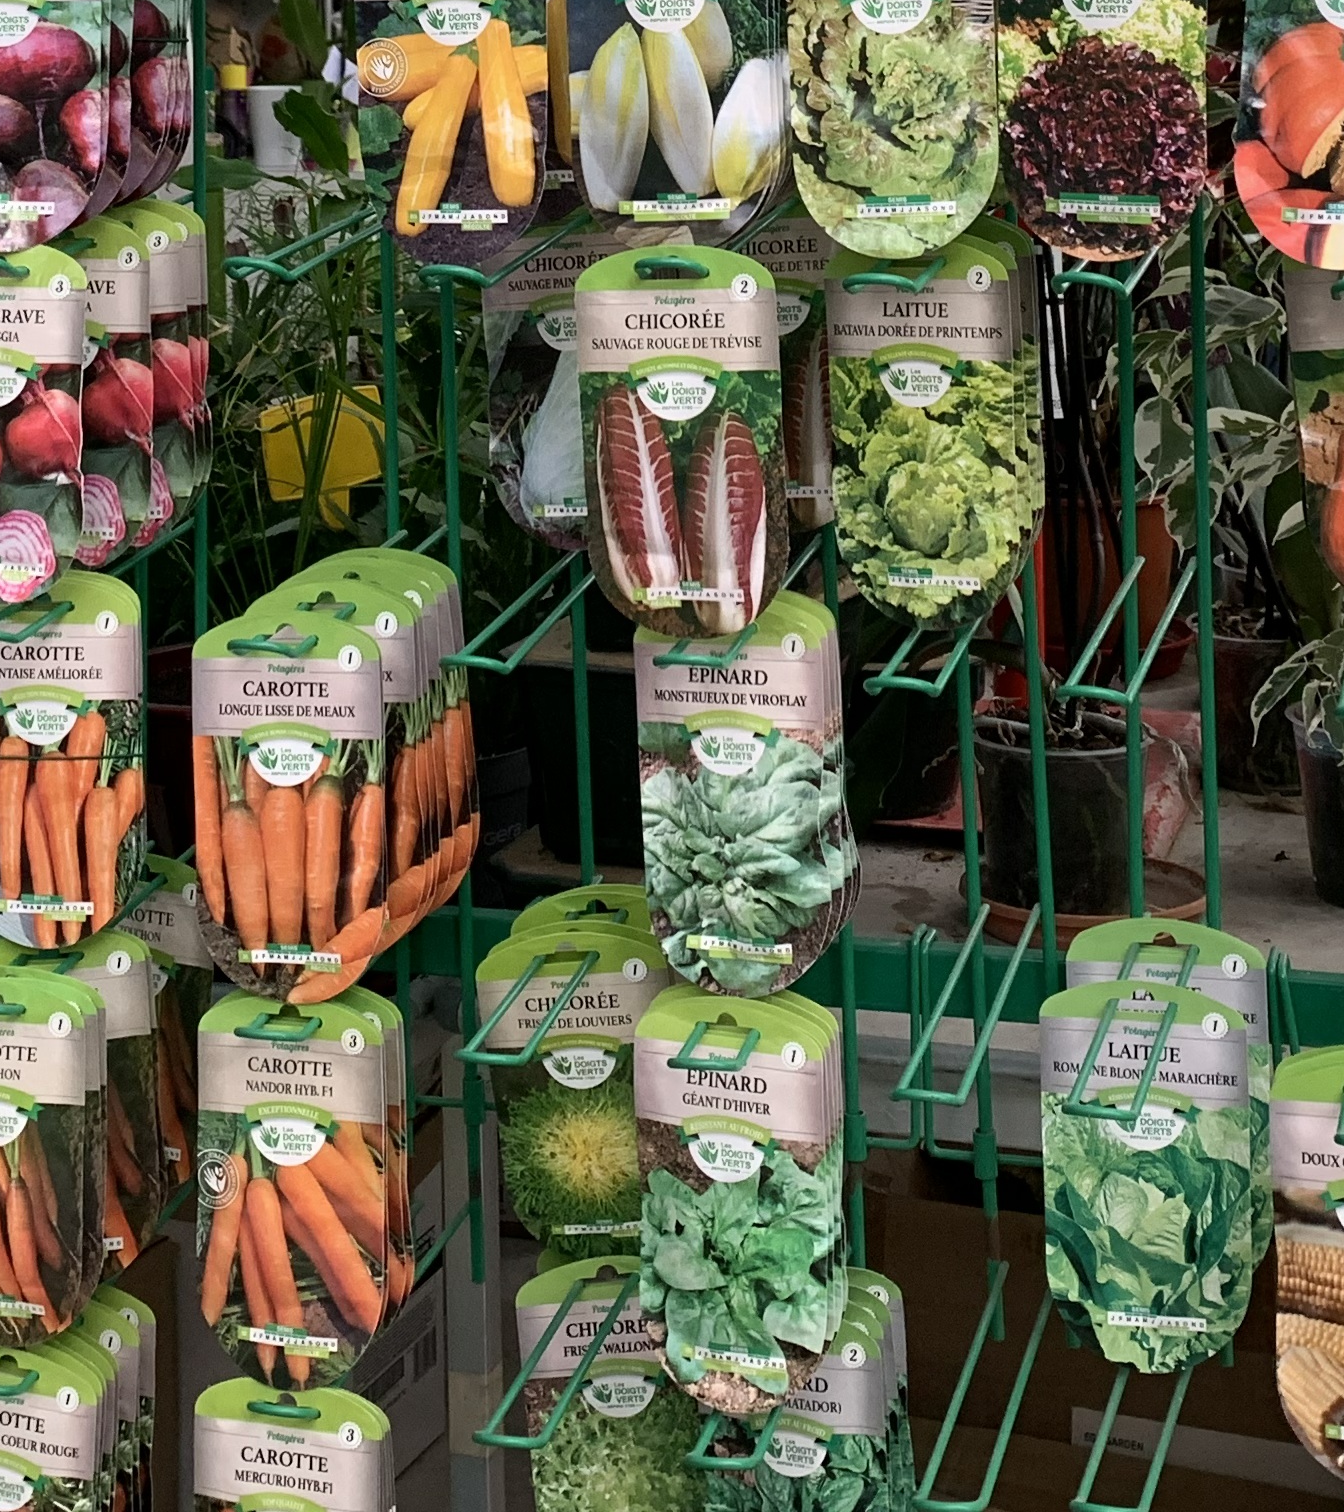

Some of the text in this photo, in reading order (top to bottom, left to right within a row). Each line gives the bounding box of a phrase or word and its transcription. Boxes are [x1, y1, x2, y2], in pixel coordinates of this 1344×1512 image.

[883, 302, 948, 317] LAITUE
[625, 313, 724, 329] CHICORÉE
[1, 646, 84, 660] CAROTTE
[38, 666, 101, 679] AMÉLIORÉE
[243, 681, 328, 697] CAROTTE
[248, 1057, 332, 1076] CAROTTE
[683, 1093, 770, 1115] GÉANT D'HIVER
[1302, 1152, 1339, 1167] DOUX
[241, 1447, 328, 1472] CAROTTE
